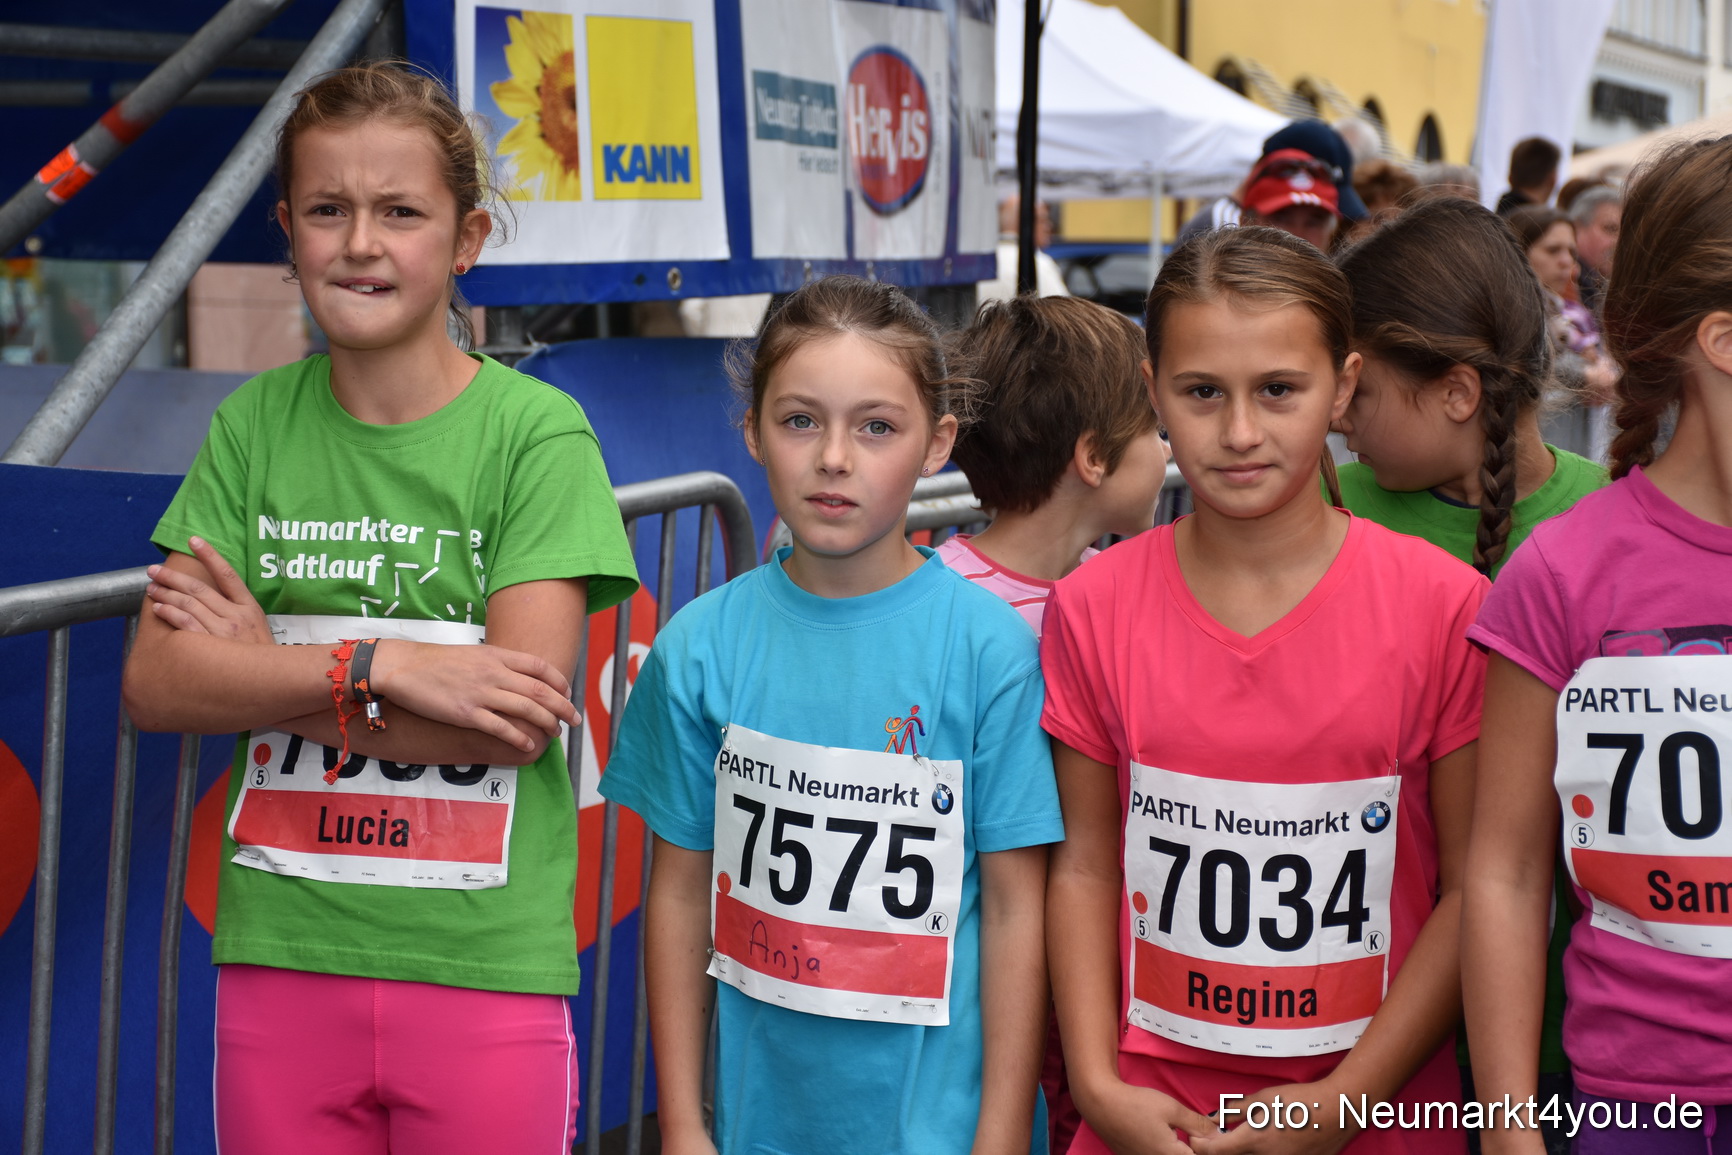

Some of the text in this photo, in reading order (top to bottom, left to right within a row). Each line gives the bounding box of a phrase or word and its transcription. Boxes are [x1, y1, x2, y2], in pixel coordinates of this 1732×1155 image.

[848, 82, 928, 176] Hervis
[602, 144, 690, 183] KANN
[1566, 687, 1664, 713] PARTL
[256, 769, 265, 785] 5
[490, 781, 501, 797] K
[719, 749, 920, 808] PARTL Neumarkt
[1587, 731, 1723, 840] 70
[317, 806, 410, 848] Lucia
[1131, 790, 1350, 837] PARTL Neumarkt
[1578, 826, 1588, 844] 5
[733, 793, 936, 919] 7575
[1149, 836, 1370, 952] 7034
[1647, 869, 1732, 914] Sam
[932, 915, 942, 930] K
[1138, 919, 1146, 936] 5
[1369, 933, 1379, 951] K
[749, 920, 820, 979] Anja
[1187, 970, 1318, 1025] Regina
